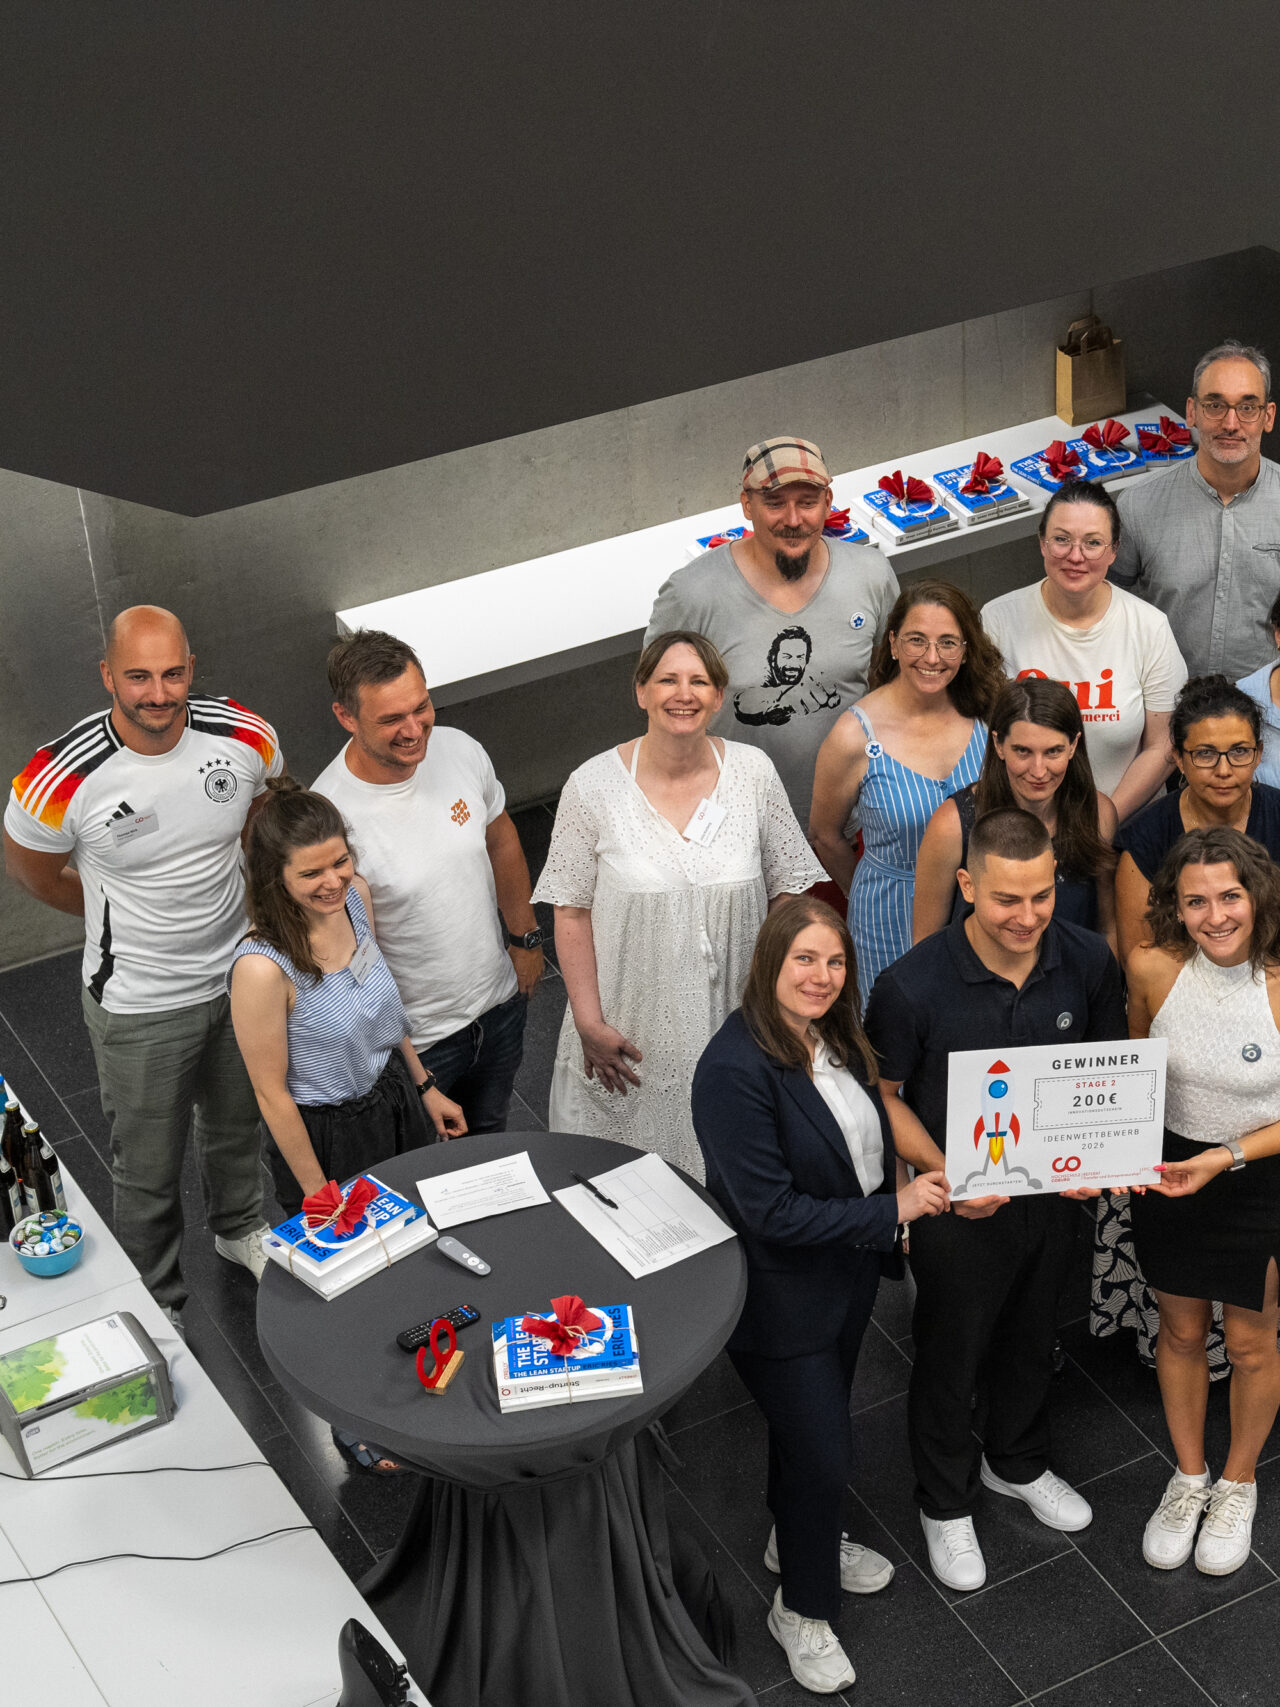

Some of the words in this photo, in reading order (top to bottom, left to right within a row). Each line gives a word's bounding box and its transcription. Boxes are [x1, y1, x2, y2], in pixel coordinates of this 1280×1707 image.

[1016, 459, 1036, 468] THE
[938, 471, 958, 480] THE
[868, 491, 887, 500] THE
[1082, 710, 1120, 722] merci
[1051, 1054, 1140, 1071] GEWINNER
[1075, 1079, 1107, 1089] STAGE
[1111, 1079, 1117, 1087] 2
[1073, 1092, 1118, 1108] 200€
[1043, 1128, 1141, 1143] IDEENWETTBEWERB
[1081, 1141, 1105, 1150] 2026
[376, 1197, 404, 1216] EAN
[611, 1332, 626, 1357] ERIC
[517, 1346, 531, 1368] THE
[513, 1370, 528, 1378] THE
[529, 1368, 548, 1376] LEAN
[550, 1365, 581, 1374] STARTUP
[583, 1362, 600, 1370] ERIC
[520, 1381, 580, 1393] Startup-Recht
